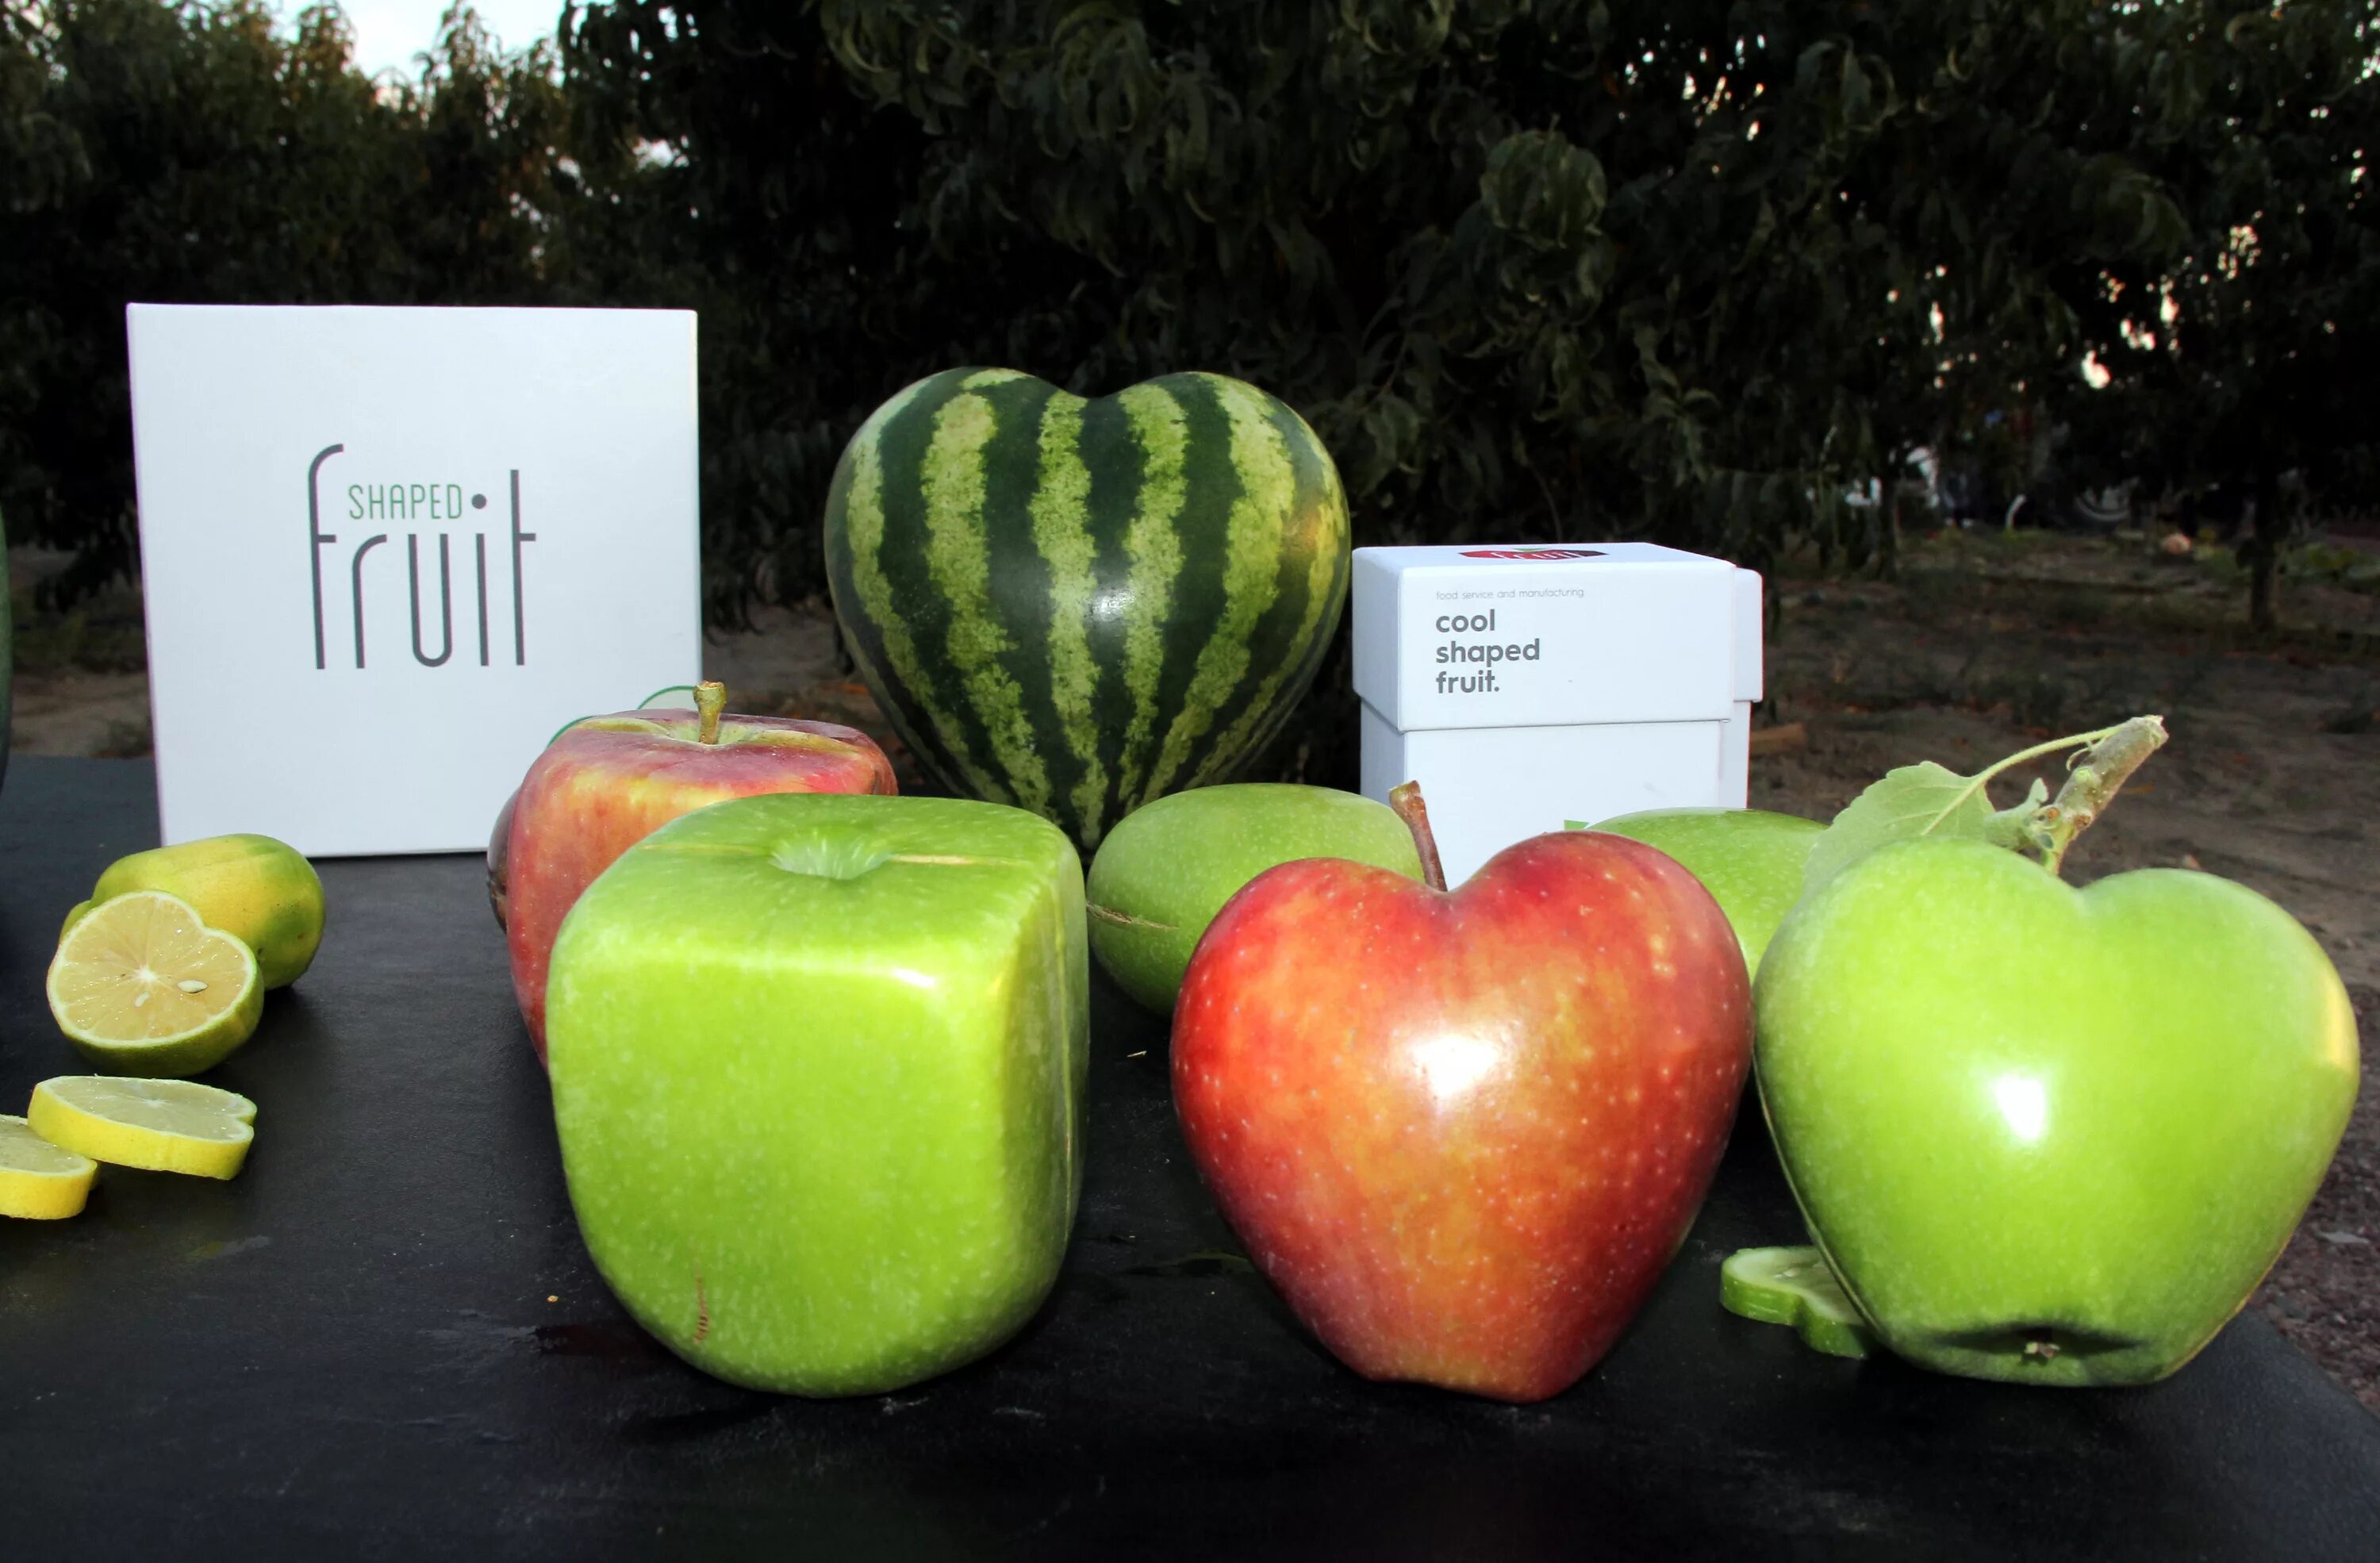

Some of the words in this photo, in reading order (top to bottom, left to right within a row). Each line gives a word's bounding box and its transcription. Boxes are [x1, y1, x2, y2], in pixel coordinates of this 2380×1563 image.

[347, 483, 463, 520] SHAPED
[308, 443, 536, 670] fruit
[1436, 590, 1458, 600] food
[1461, 590, 1493, 599] service
[1518, 588, 1584, 597] manufacturing
[1435, 609, 1495, 633] cool
[1435, 638, 1540, 667] shaped
[1435, 670, 1500, 694] fruit.
